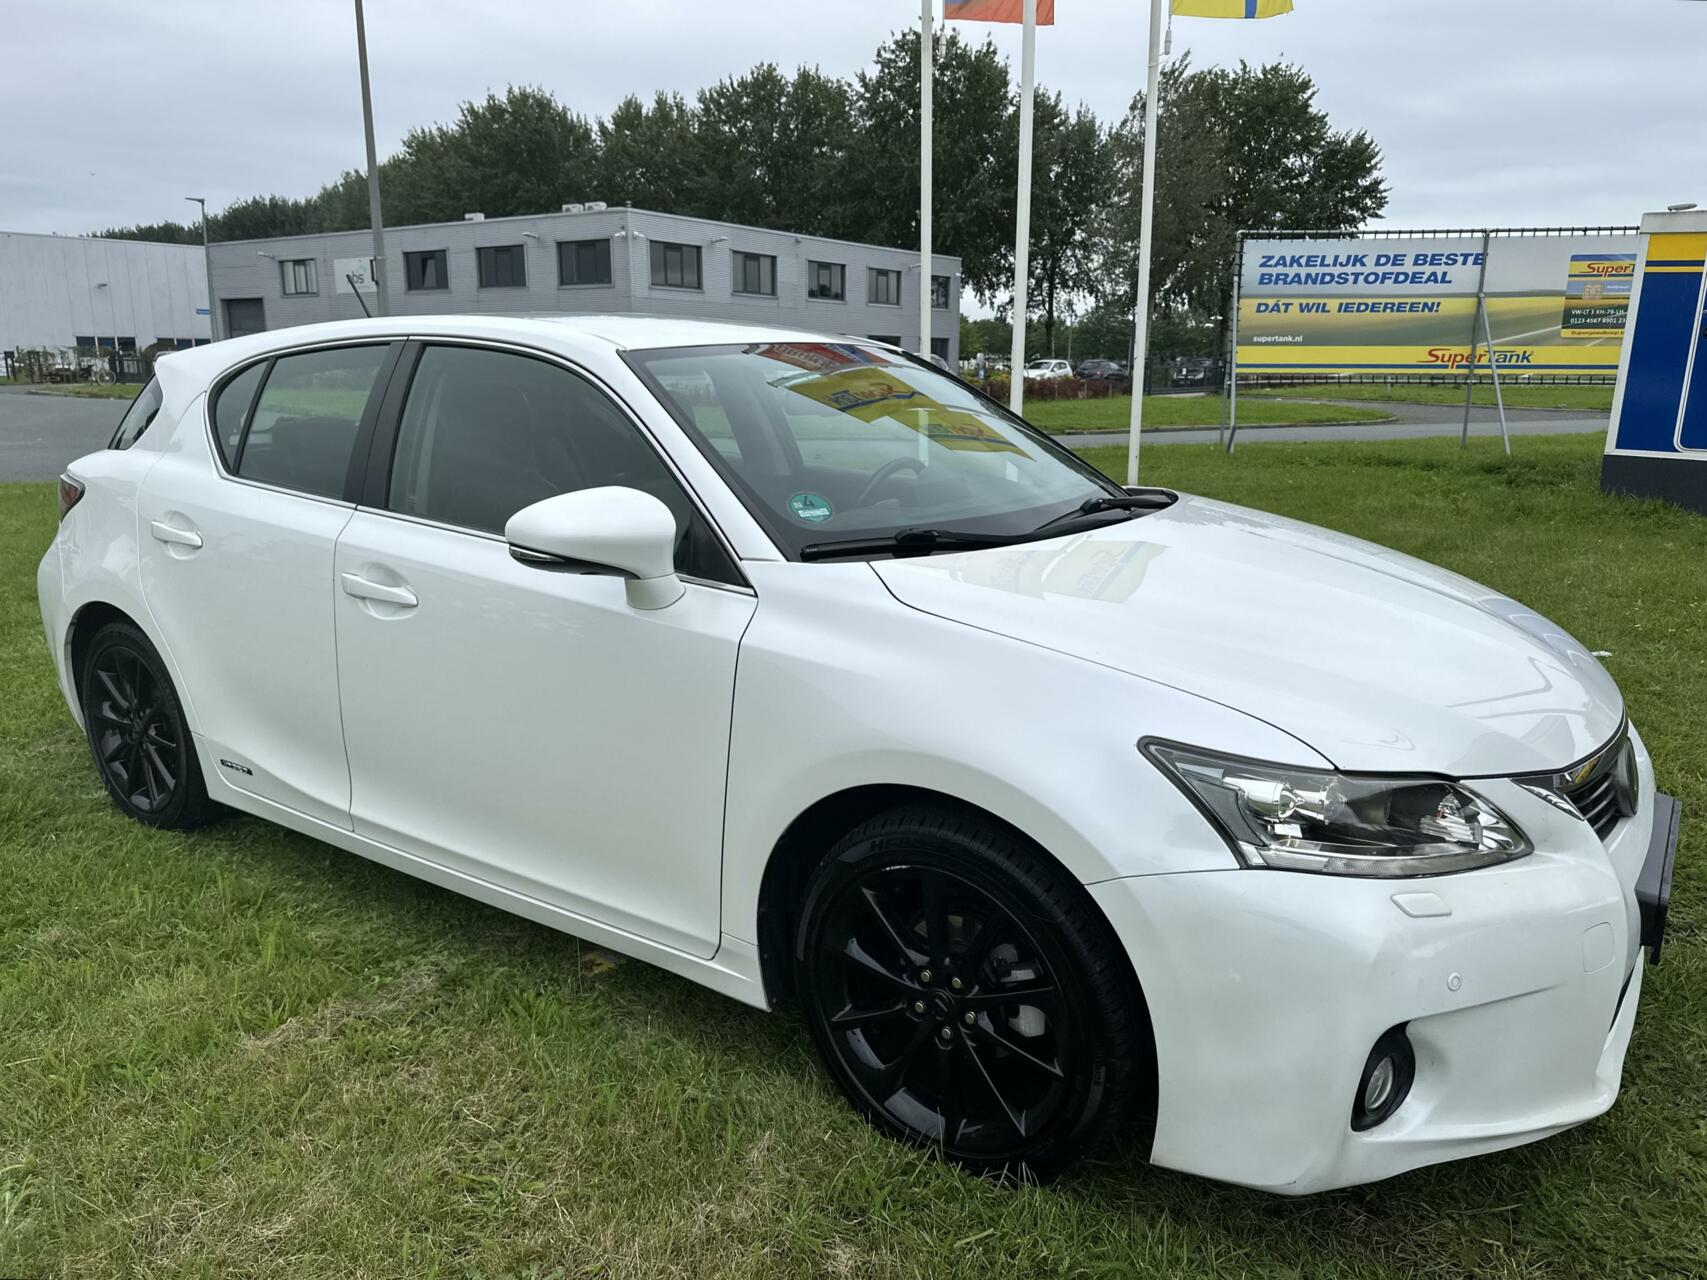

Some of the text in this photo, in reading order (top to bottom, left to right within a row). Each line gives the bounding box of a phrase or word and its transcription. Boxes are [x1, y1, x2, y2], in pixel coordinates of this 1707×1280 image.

[1259, 254, 1368, 268] ZAKELIJK
[1374, 254, 1407, 267] DE
[1258, 271, 1452, 285] BRANDSTOFDEAL
[1256, 300, 1441, 313] DÁT WIL IEDEREEN!
[1253, 335, 1303, 343] supertank.nl
